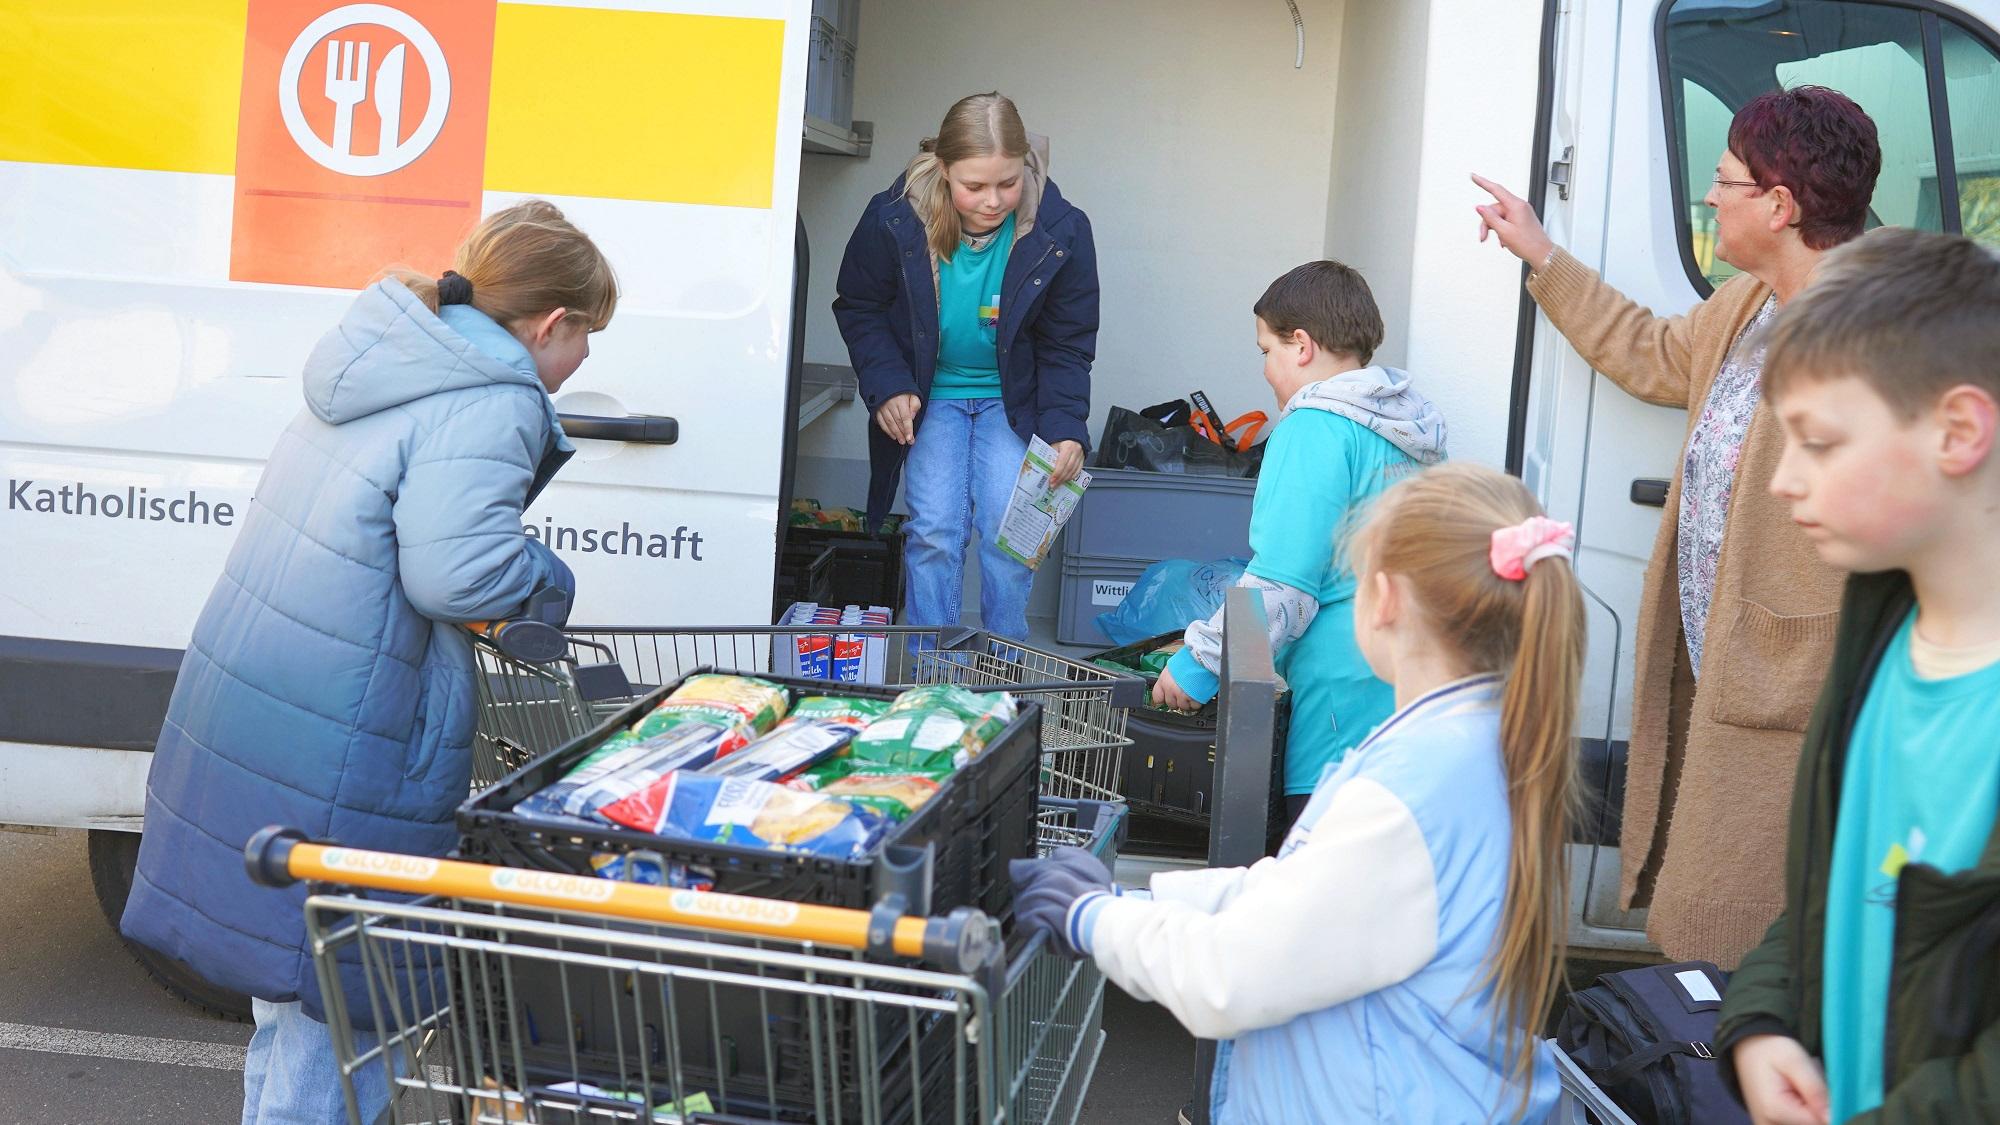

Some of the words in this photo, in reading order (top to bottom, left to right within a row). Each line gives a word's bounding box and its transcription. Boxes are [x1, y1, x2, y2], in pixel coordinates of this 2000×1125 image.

[8, 479, 234, 526] Katholische
[344, 851, 431, 874] GLOBUS
[516, 874, 606, 897] GLOBUS
[697, 896, 789, 922] GLOBUS
